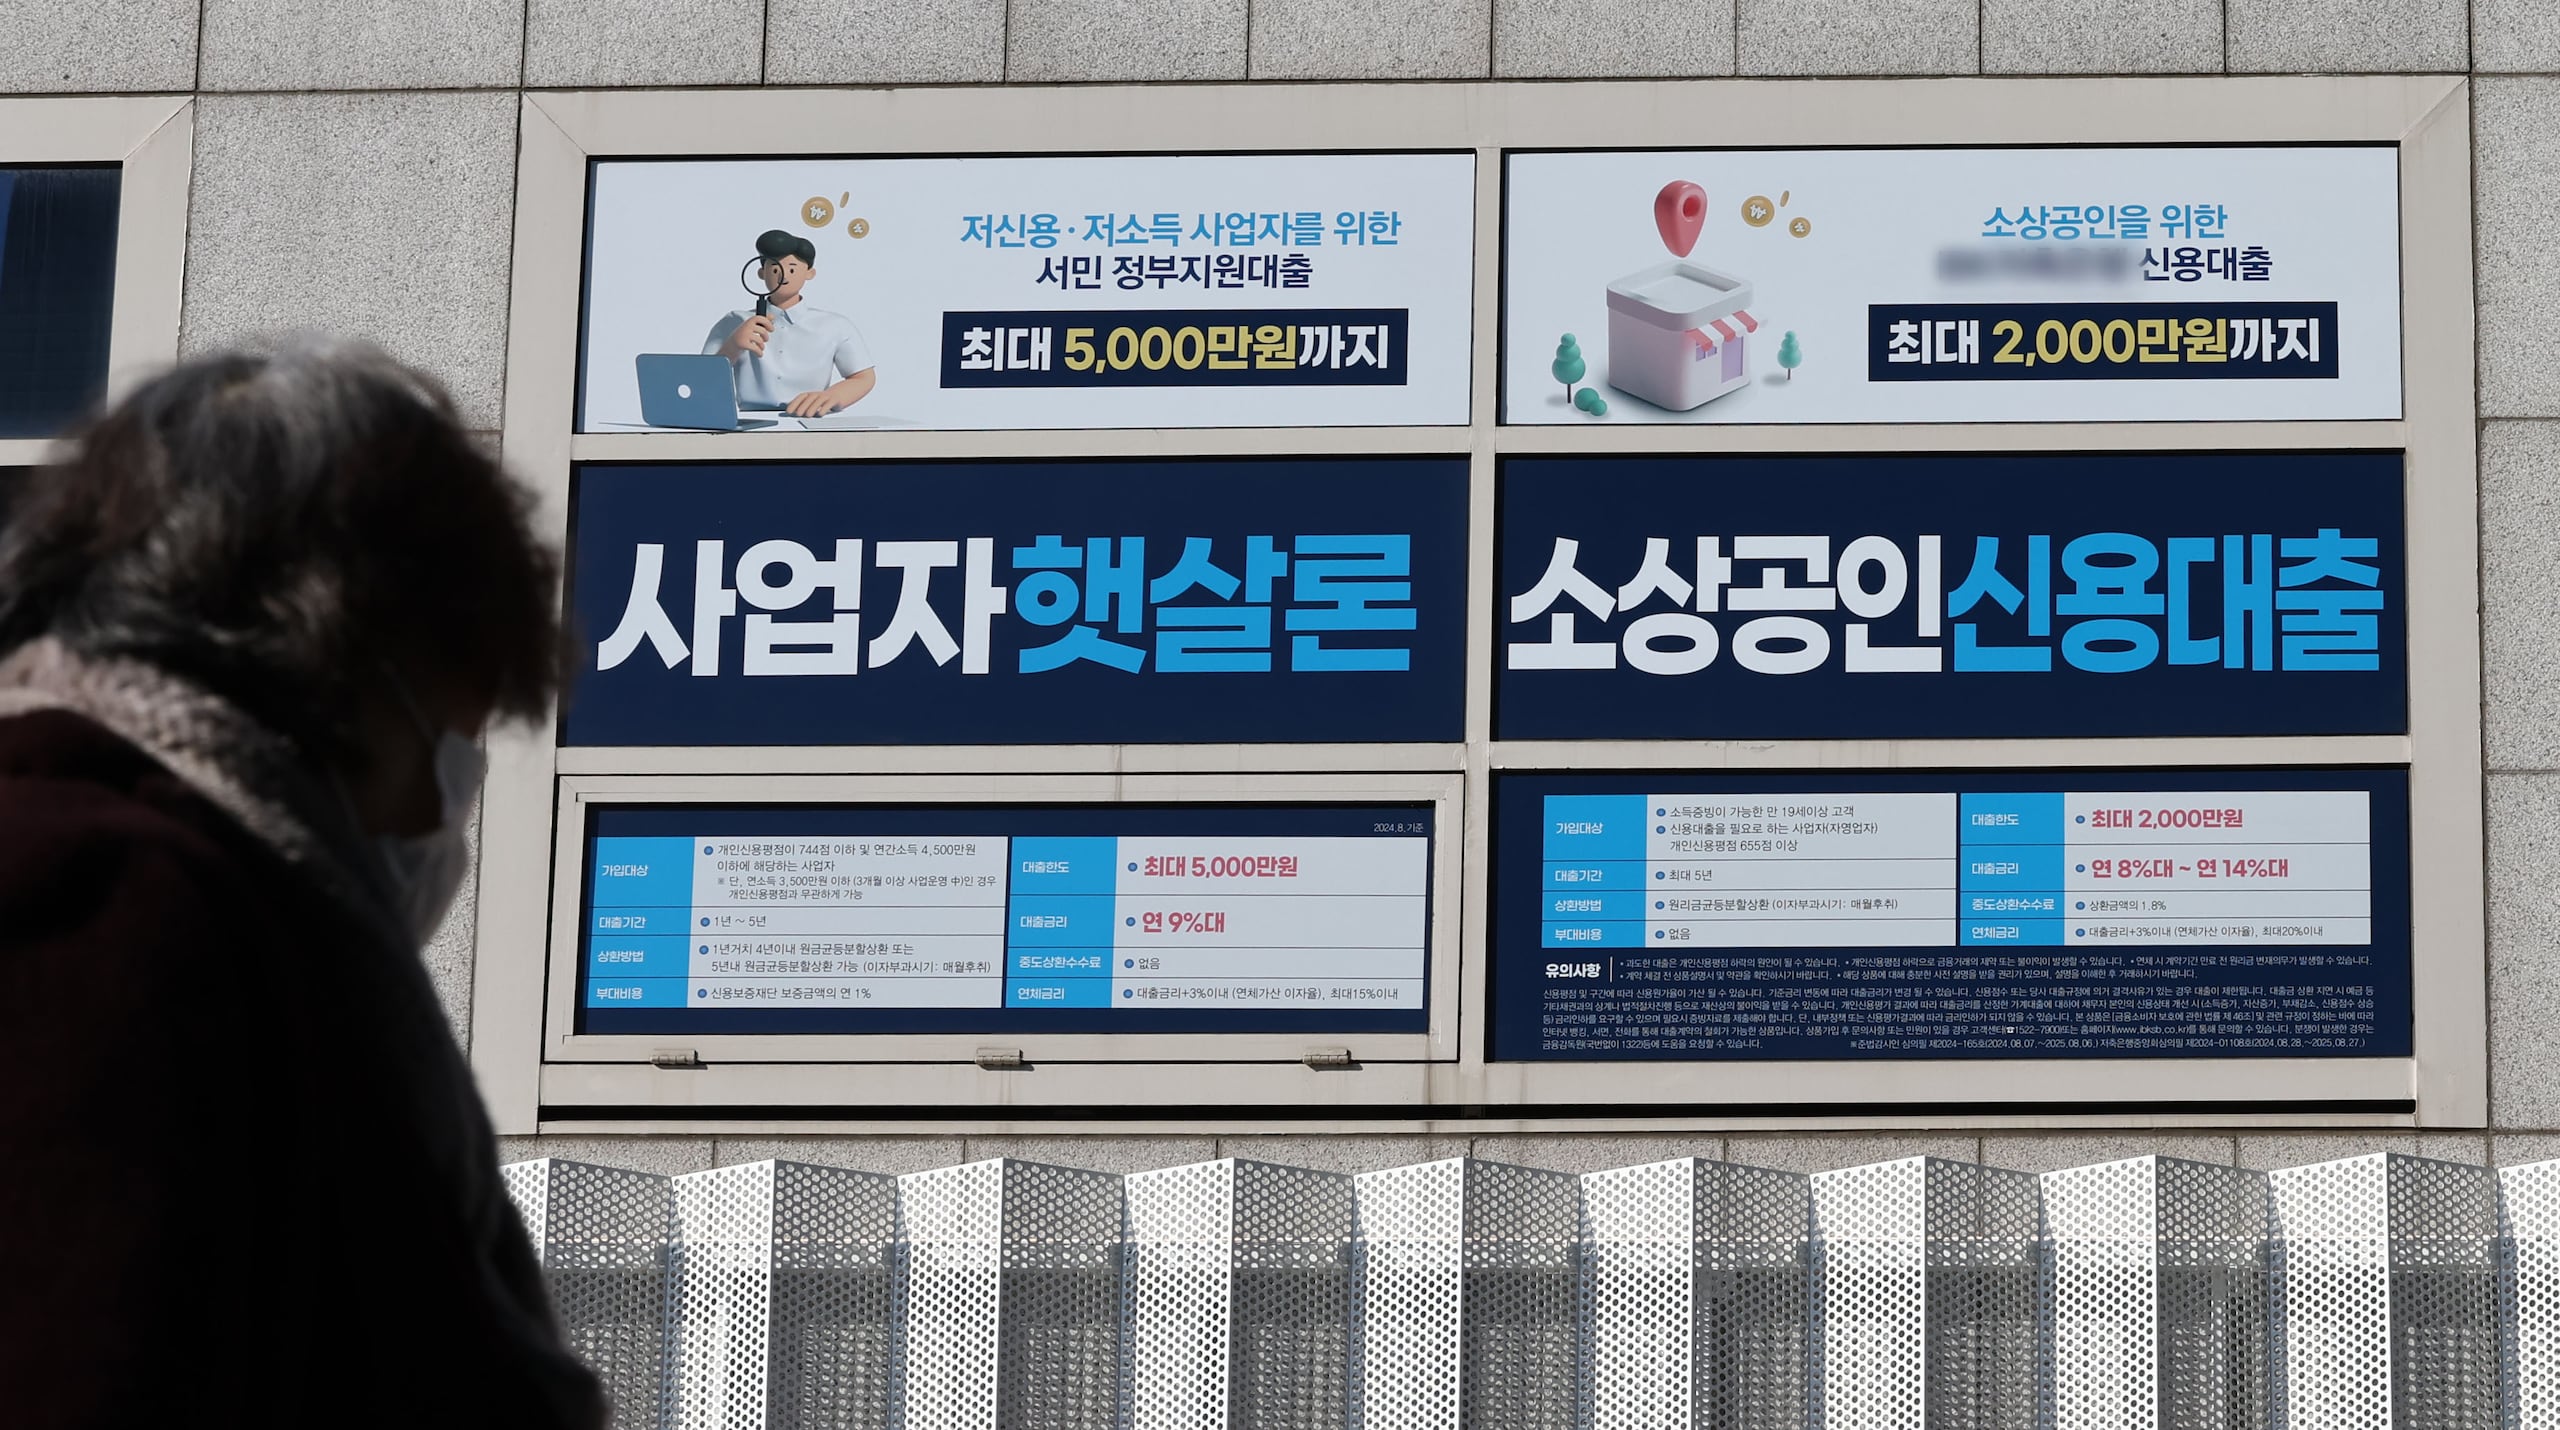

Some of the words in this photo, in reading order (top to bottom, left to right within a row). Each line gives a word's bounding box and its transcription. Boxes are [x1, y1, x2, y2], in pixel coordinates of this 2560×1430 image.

[1190, 212, 1325, 246] 사업자를
[1334, 211, 1402, 245] 위한
[1982, 205, 2151, 240] 소상공인을
[2160, 205, 2228, 239] 위한
[2138, 246, 2272, 282] 신용대출
[1036, 256, 1101, 290] 서민
[1112, 254, 1313, 289] 정부지원대출
[1888, 320, 1979, 364] 최대
[1993, 318, 2319, 366] 2,000만원까지
[961, 327, 1051, 371] 최대
[1065, 325, 1388, 373] 5,000만원까지
[1671, 807, 1725, 818] 소득증빙이
[1730, 806, 1763, 818] 가능한
[1767, 806, 1777, 817] 만
[1783, 806, 1828, 817] 19세이상
[1832, 806, 1853, 817] 고객
[1972, 814, 2019, 825] 대출한도
[2092, 810, 2132, 828] 최대
[2139, 809, 2242, 829] 2,000만원
[1556, 823, 1603, 834] 가입대상
[1671, 823, 1726, 835] 신용대출을
[1730, 824, 1763, 834] 필요로
[1767, 823, 1788, 834] 하는
[1793, 823, 1877, 834] 사업자(자영업자)
[718, 844, 794, 856] 개인신용평점이
[800, 844, 829, 855] 744점
[834, 844, 856, 855] 이하
[860, 844, 869, 855] 및
[874, 844, 918, 855] 연간소득
[922, 844, 975, 856] 4,500만원
[1671, 840, 1736, 852] 개인신용평점
[1741, 840, 1771, 851] 655점
[1776, 840, 1797, 851] 이상
[602, 865, 648, 876] 가입대상
[718, 860, 750, 872] 이하에
[754, 860, 798, 872] 해당하는
[802, 860, 835, 872] 사업자
[1023, 861, 1069, 873] 대출한도
[1144, 856, 1185, 877] 최대
[1192, 856, 1297, 878] 5,000만원
[1972, 863, 2018, 874] 대출금리
[2092, 860, 2111, 878] 연
[2118, 859, 2173, 878] 8%대
[2197, 859, 2216, 877] 연
[2223, 859, 2288, 877] 14%대
[1555, 870, 1602, 881] 대출기간
[1669, 870, 1690, 881] 최대
[1695, 870, 1711, 881] 5년
[747, 876, 776, 886] 연소득
[779, 876, 827, 887] 3,500만원
[831, 876, 850, 886] 이하
[853, 876, 882, 886] (3개월
[886, 876, 905, 888] 이상
[908, 876, 947, 886] 사업운영
[977, 876, 996, 886] 경우
[729, 889, 797, 900] 개인신용평점과
[801, 889, 840, 899] 무관하게
[844, 889, 862, 900] 가능
[1555, 900, 1601, 911] 상환방법
[1669, 899, 1769, 911] 원리금균등분할상환
[1773, 899, 1845, 910] (이자부과시기:
[1851, 899, 1897, 909] 매월후취)
[1972, 899, 2054, 910] 중도상환수수료
[2090, 900, 2138, 911] 상환금액의
[2142, 901, 2166, 911] 1.8%
[599, 917, 646, 928] 대출기간
[715, 916, 731, 927] 1년
[749, 916, 766, 927] 5년
[1021, 916, 1067, 928] 대출금리
[1143, 912, 1162, 932] 연
[1169, 912, 1224, 933] 9%대
[1555, 929, 1601, 941] 부대비용
[1669, 928, 1690, 940] 없음
[1972, 927, 2018, 938] 연체금리
[2088, 927, 2171, 937] 대출금리+3%이내
[2175, 927, 2217, 937] (연체가산
[2221, 926, 2257, 937] 이자율),
[2263, 926, 2322, 936] 최대20%이내
[714, 944, 752, 955] 1년거치
[756, 944, 795, 955] 4년이내
[800, 943, 888, 955] 원금균등분할상환
[892, 944, 914, 955] 또는
[598, 951, 643, 962] 상환방법
[1019, 956, 1101, 968] 중도상환수수료
[712, 961, 740, 972] 5년내
[745, 961, 832, 972] 원금균등분할상환
[837, 961, 858, 972] 가능
[864, 961, 937, 973] (이자부과시기:
[943, 961, 990, 973] 매월후취)
[1139, 958, 1160, 969] 없음
[1546, 963, 1601, 978] 유의사항
[596, 988, 642, 999] 부대비용
[711, 988, 777, 999] 신용보증재단
[781, 988, 836, 999] 보증금액의
[841, 988, 850, 999] 연
[856, 988, 871, 998] 1%
[1018, 988, 1064, 1000] 연체금리
[1137, 987, 1228, 999] 대출금리+3%이내
[1232, 988, 1280, 999] (연체가산
[1285, 988, 1325, 1000] 이자율),
[1331, 988, 1398, 1000] 최대15%이내
